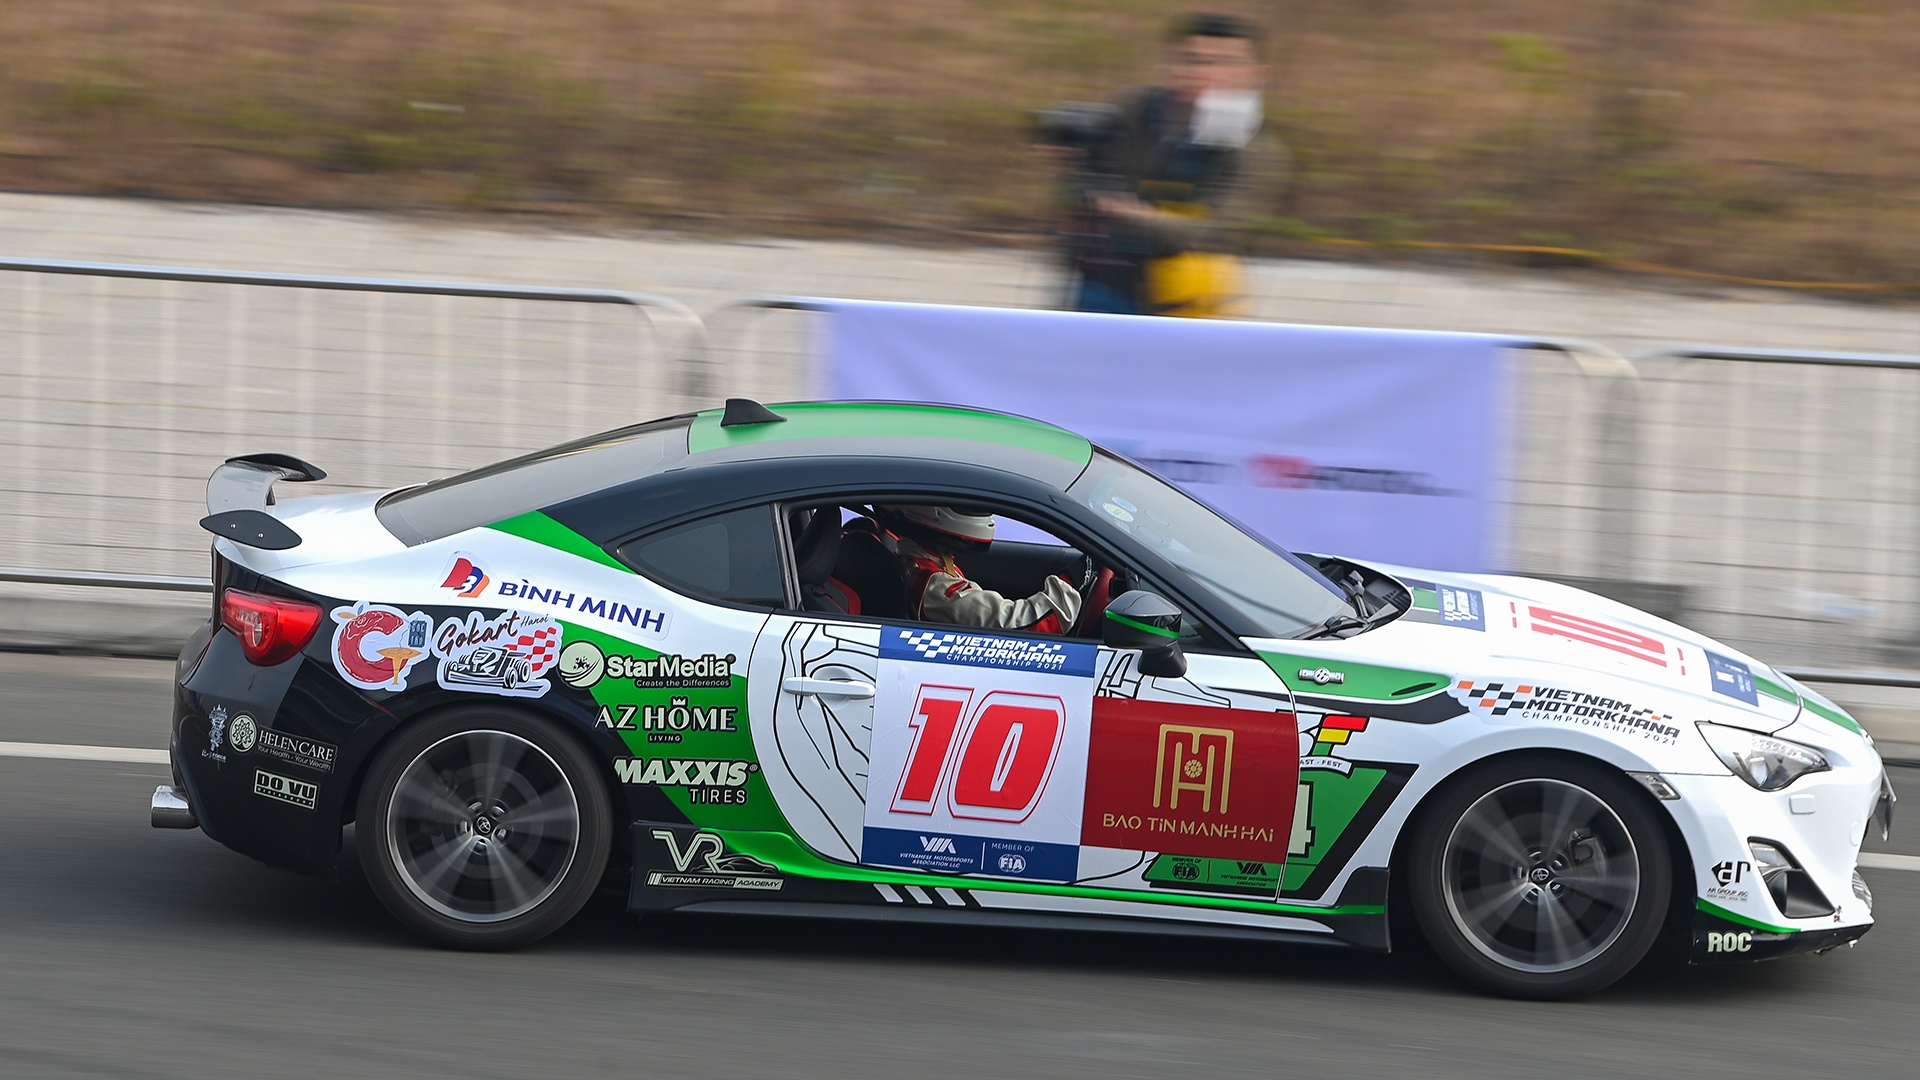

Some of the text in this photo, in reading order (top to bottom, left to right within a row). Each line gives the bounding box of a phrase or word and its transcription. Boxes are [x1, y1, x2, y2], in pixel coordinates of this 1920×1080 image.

[498, 578, 665, 633] BÌNH MINH
[438, 610, 521, 657] Gokart
[520, 614, 549, 627] Hanoi
[955, 635, 1030, 651] VIETNAM
[946, 654, 1063, 671] CHAMPIONSHIP 2021
[950, 645, 1067, 664] MOTORKHANA
[606, 655, 729, 677] StarMedia
[636, 679, 730, 687] Create the Differences
[1533, 686, 1633, 713] VIETNAM
[594, 706, 638, 729] AZ
[1525, 699, 1681, 738] MOTORKHANA
[1521, 711, 1677, 746] CHAMPIONSHIP 2021
[889, 682, 1067, 824] 10
[613, 759, 749, 786] MAXXIS
[289, 781, 316, 800] VU
[689, 788, 746, 803] TIRES
[991, 842, 1022, 851] MEMBER
[899, 852, 974, 864] VIETNAMESE MOTORSPORTS
[911, 859, 949, 867] ASSOCIATION
[999, 857, 1024, 871] FIA
[1173, 865, 1198, 877] FIA
[661, 876, 780, 887] VIETNAM RACING ACADEMY
[1707, 931, 1753, 953] ROC
